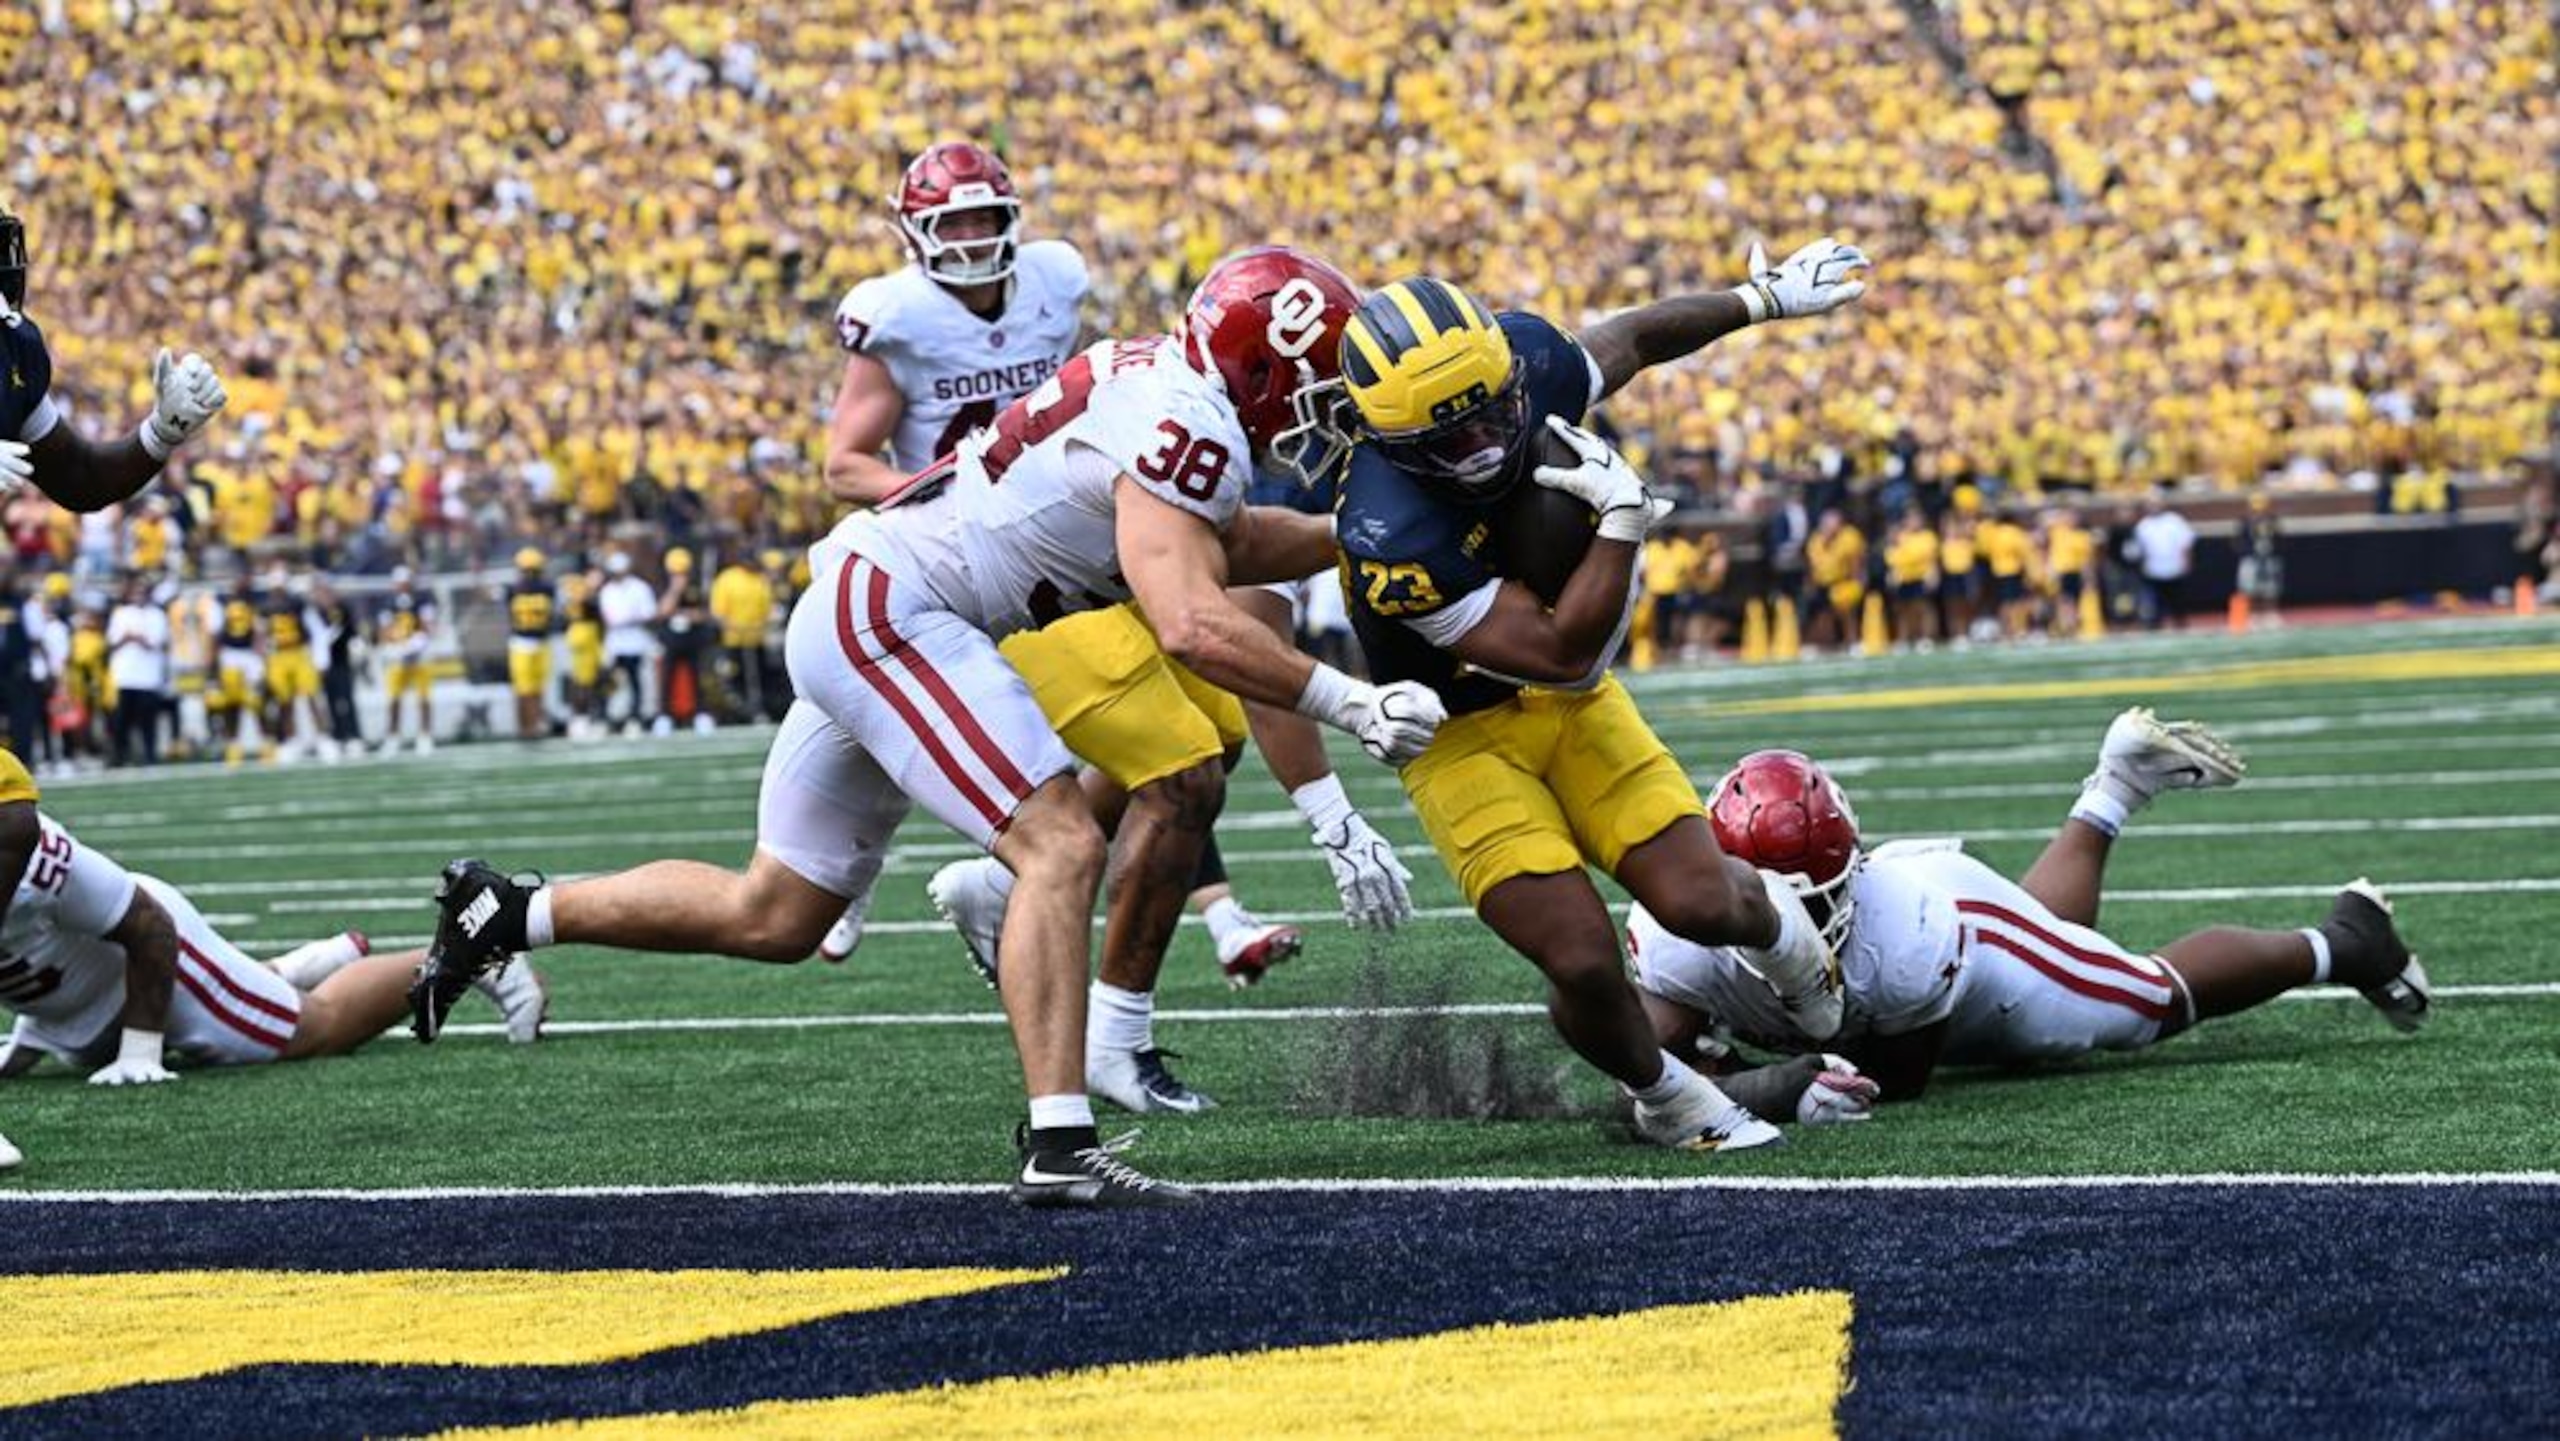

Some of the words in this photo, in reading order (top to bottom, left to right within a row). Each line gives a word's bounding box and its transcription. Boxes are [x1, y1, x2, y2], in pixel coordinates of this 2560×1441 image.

[1137, 419, 1229, 502] 38
[1361, 561, 1441, 616] 23
[32, 829, 73, 896] 55
